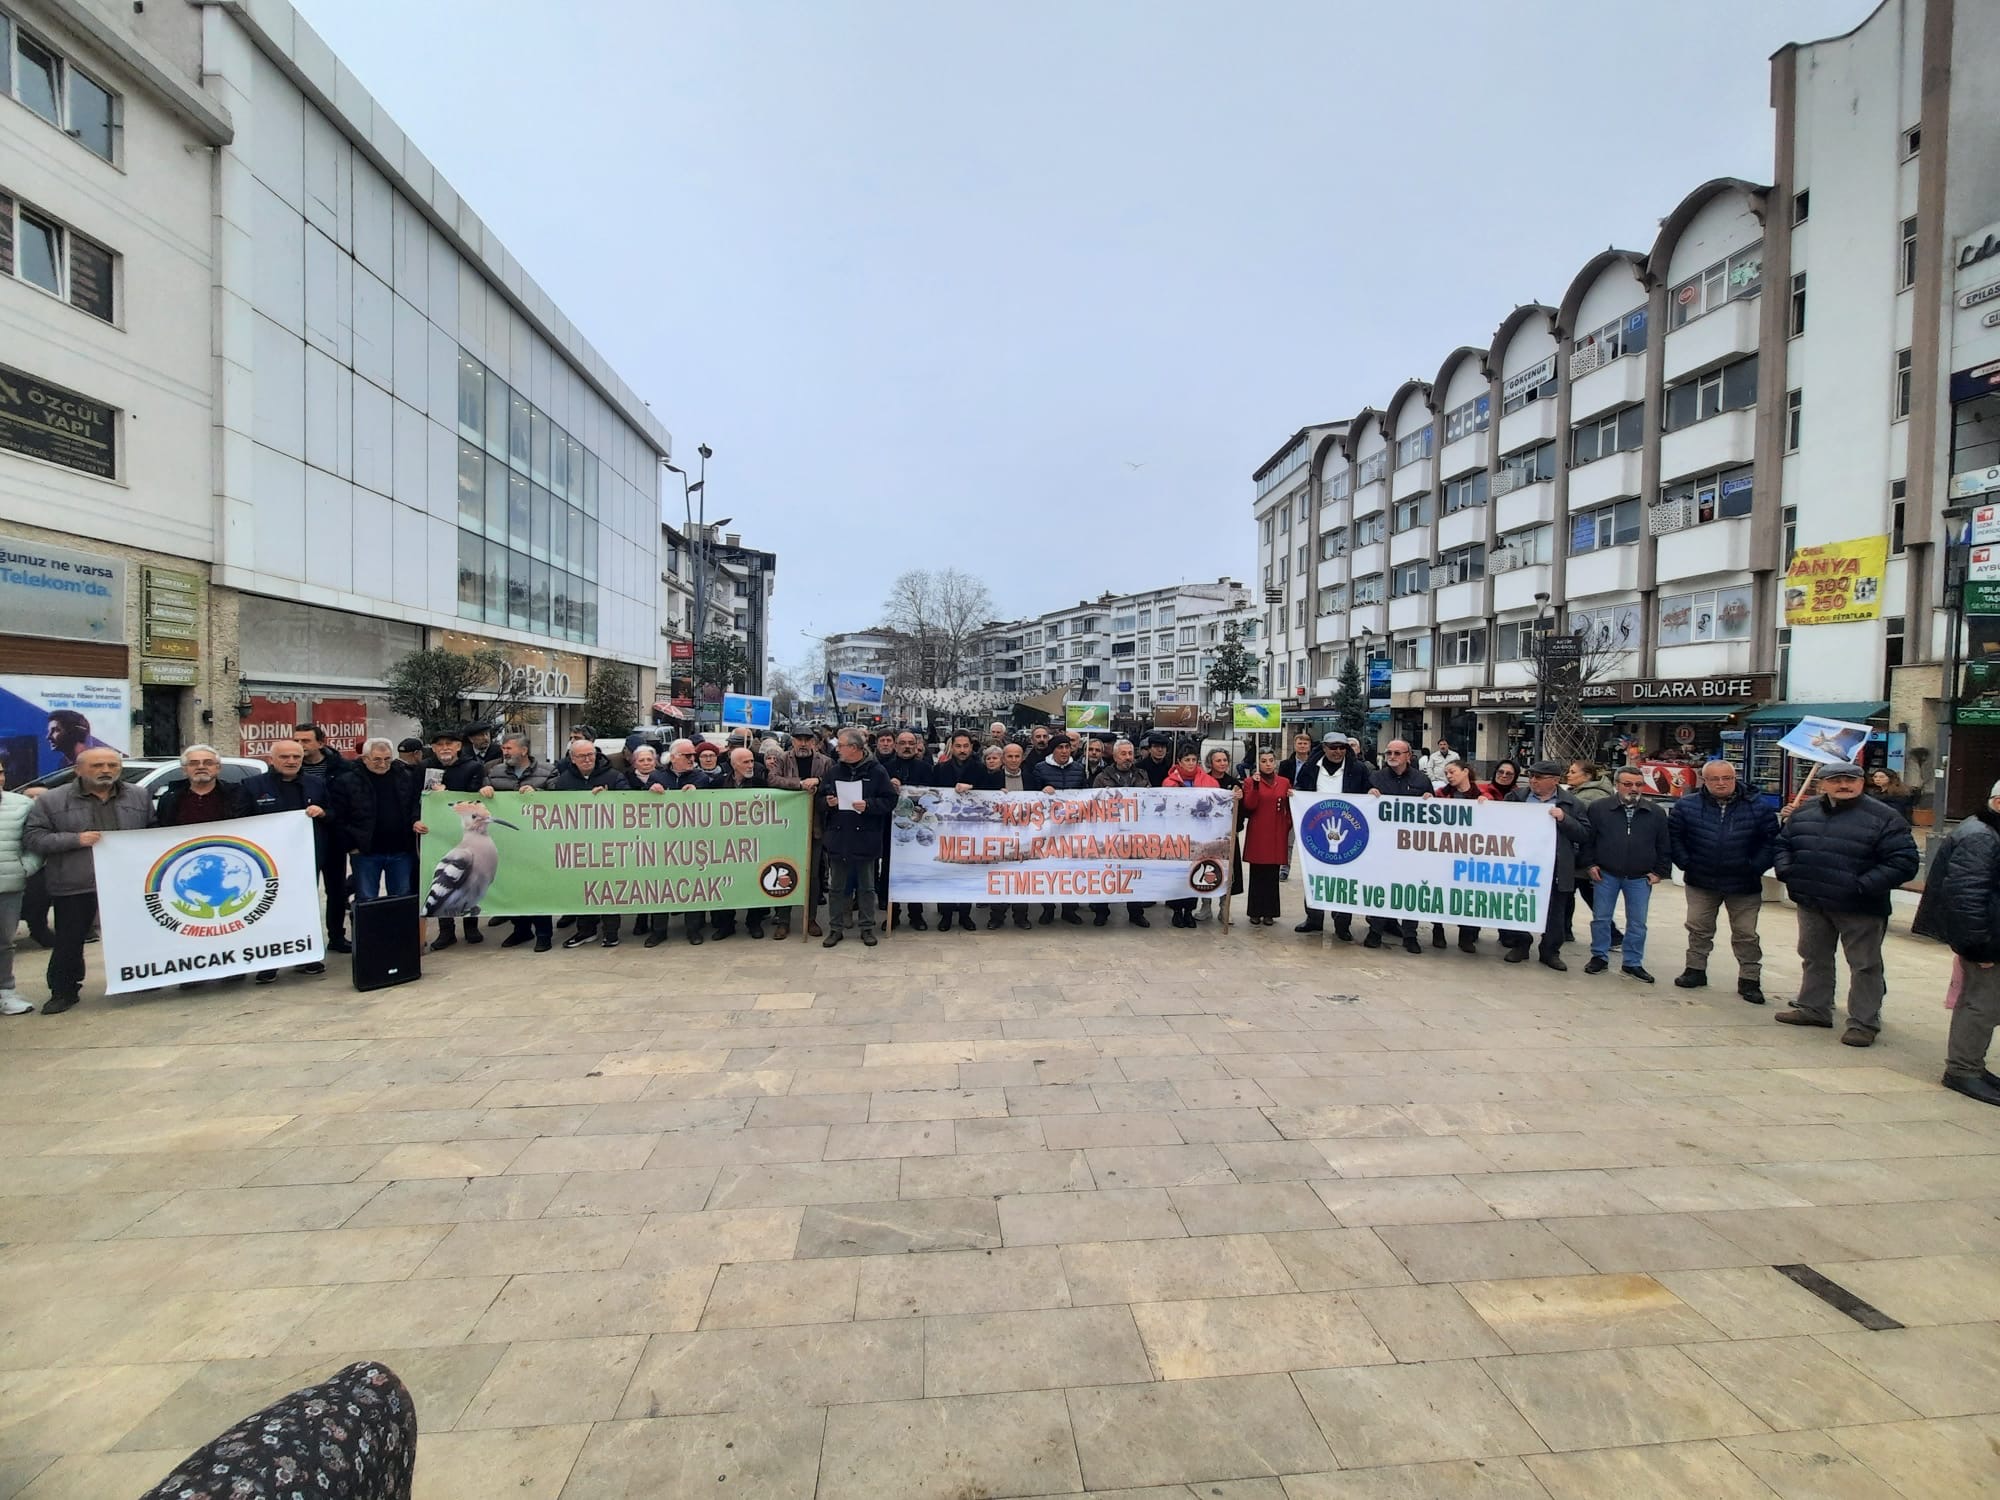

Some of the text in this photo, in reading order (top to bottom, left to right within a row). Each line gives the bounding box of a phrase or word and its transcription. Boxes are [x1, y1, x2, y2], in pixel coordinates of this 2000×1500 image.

[42, 409, 92, 437] YAPI
[51, 559, 70, 571] ne
[74, 563, 113, 579] varsa
[1811, 594, 1846, 612] 250
[1701, 679, 1752, 697] BÜFE
[247, 742, 275, 755] SAL
[330, 739, 355, 750] SALE
[623, 800, 713, 830] BETONU
[719, 794, 790, 828] DEĞİL,
[1050, 793, 1139, 824] CENNETİ
[1378, 800, 1473, 827] GİRESUN
[663, 837, 761, 871] KUŞLARI
[1030, 833, 1098, 860] RANTA
[1103, 832, 1192, 860] KURBAN
[1397, 828, 1516, 858] BULANCAK
[1453, 857, 1540, 888] PİRAZİZ
[144, 877, 280, 938] BİRLEŞİK EMEKLİLER SENDİKASI
[1362, 883, 1386, 908] ve
[1390, 880, 1443, 914] DOĞA
[1450, 888, 1536, 923] DERNEĞİ
[120, 934, 312, 983] BULANCAK ŞUBESİ
